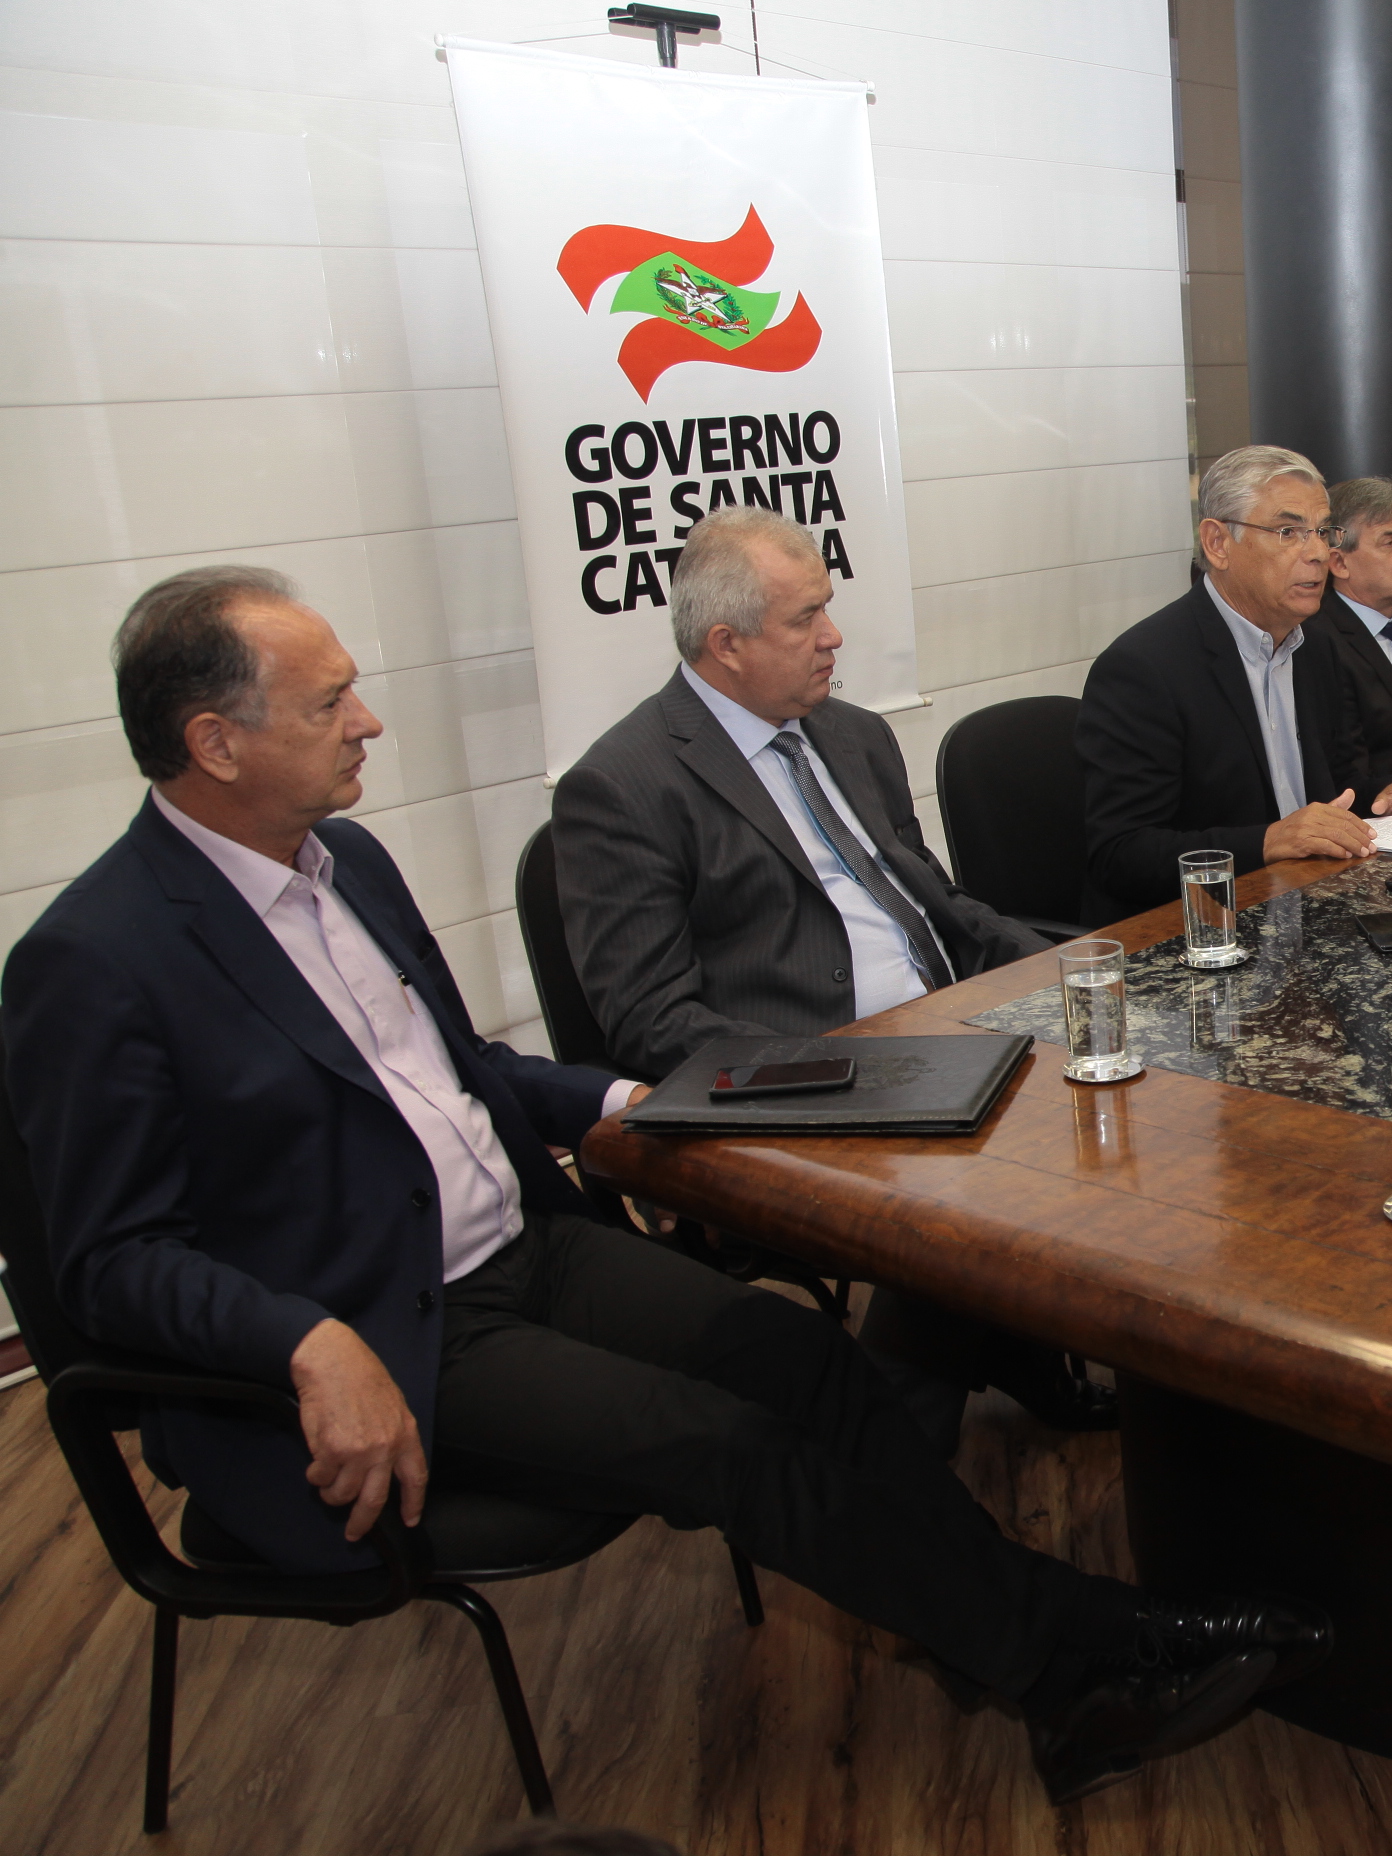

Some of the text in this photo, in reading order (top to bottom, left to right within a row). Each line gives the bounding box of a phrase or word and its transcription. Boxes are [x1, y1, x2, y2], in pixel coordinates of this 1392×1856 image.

[565, 410, 841, 483] GOVERNO
[572, 486, 657, 551] DE
[581, 528, 854, 615] CATA
